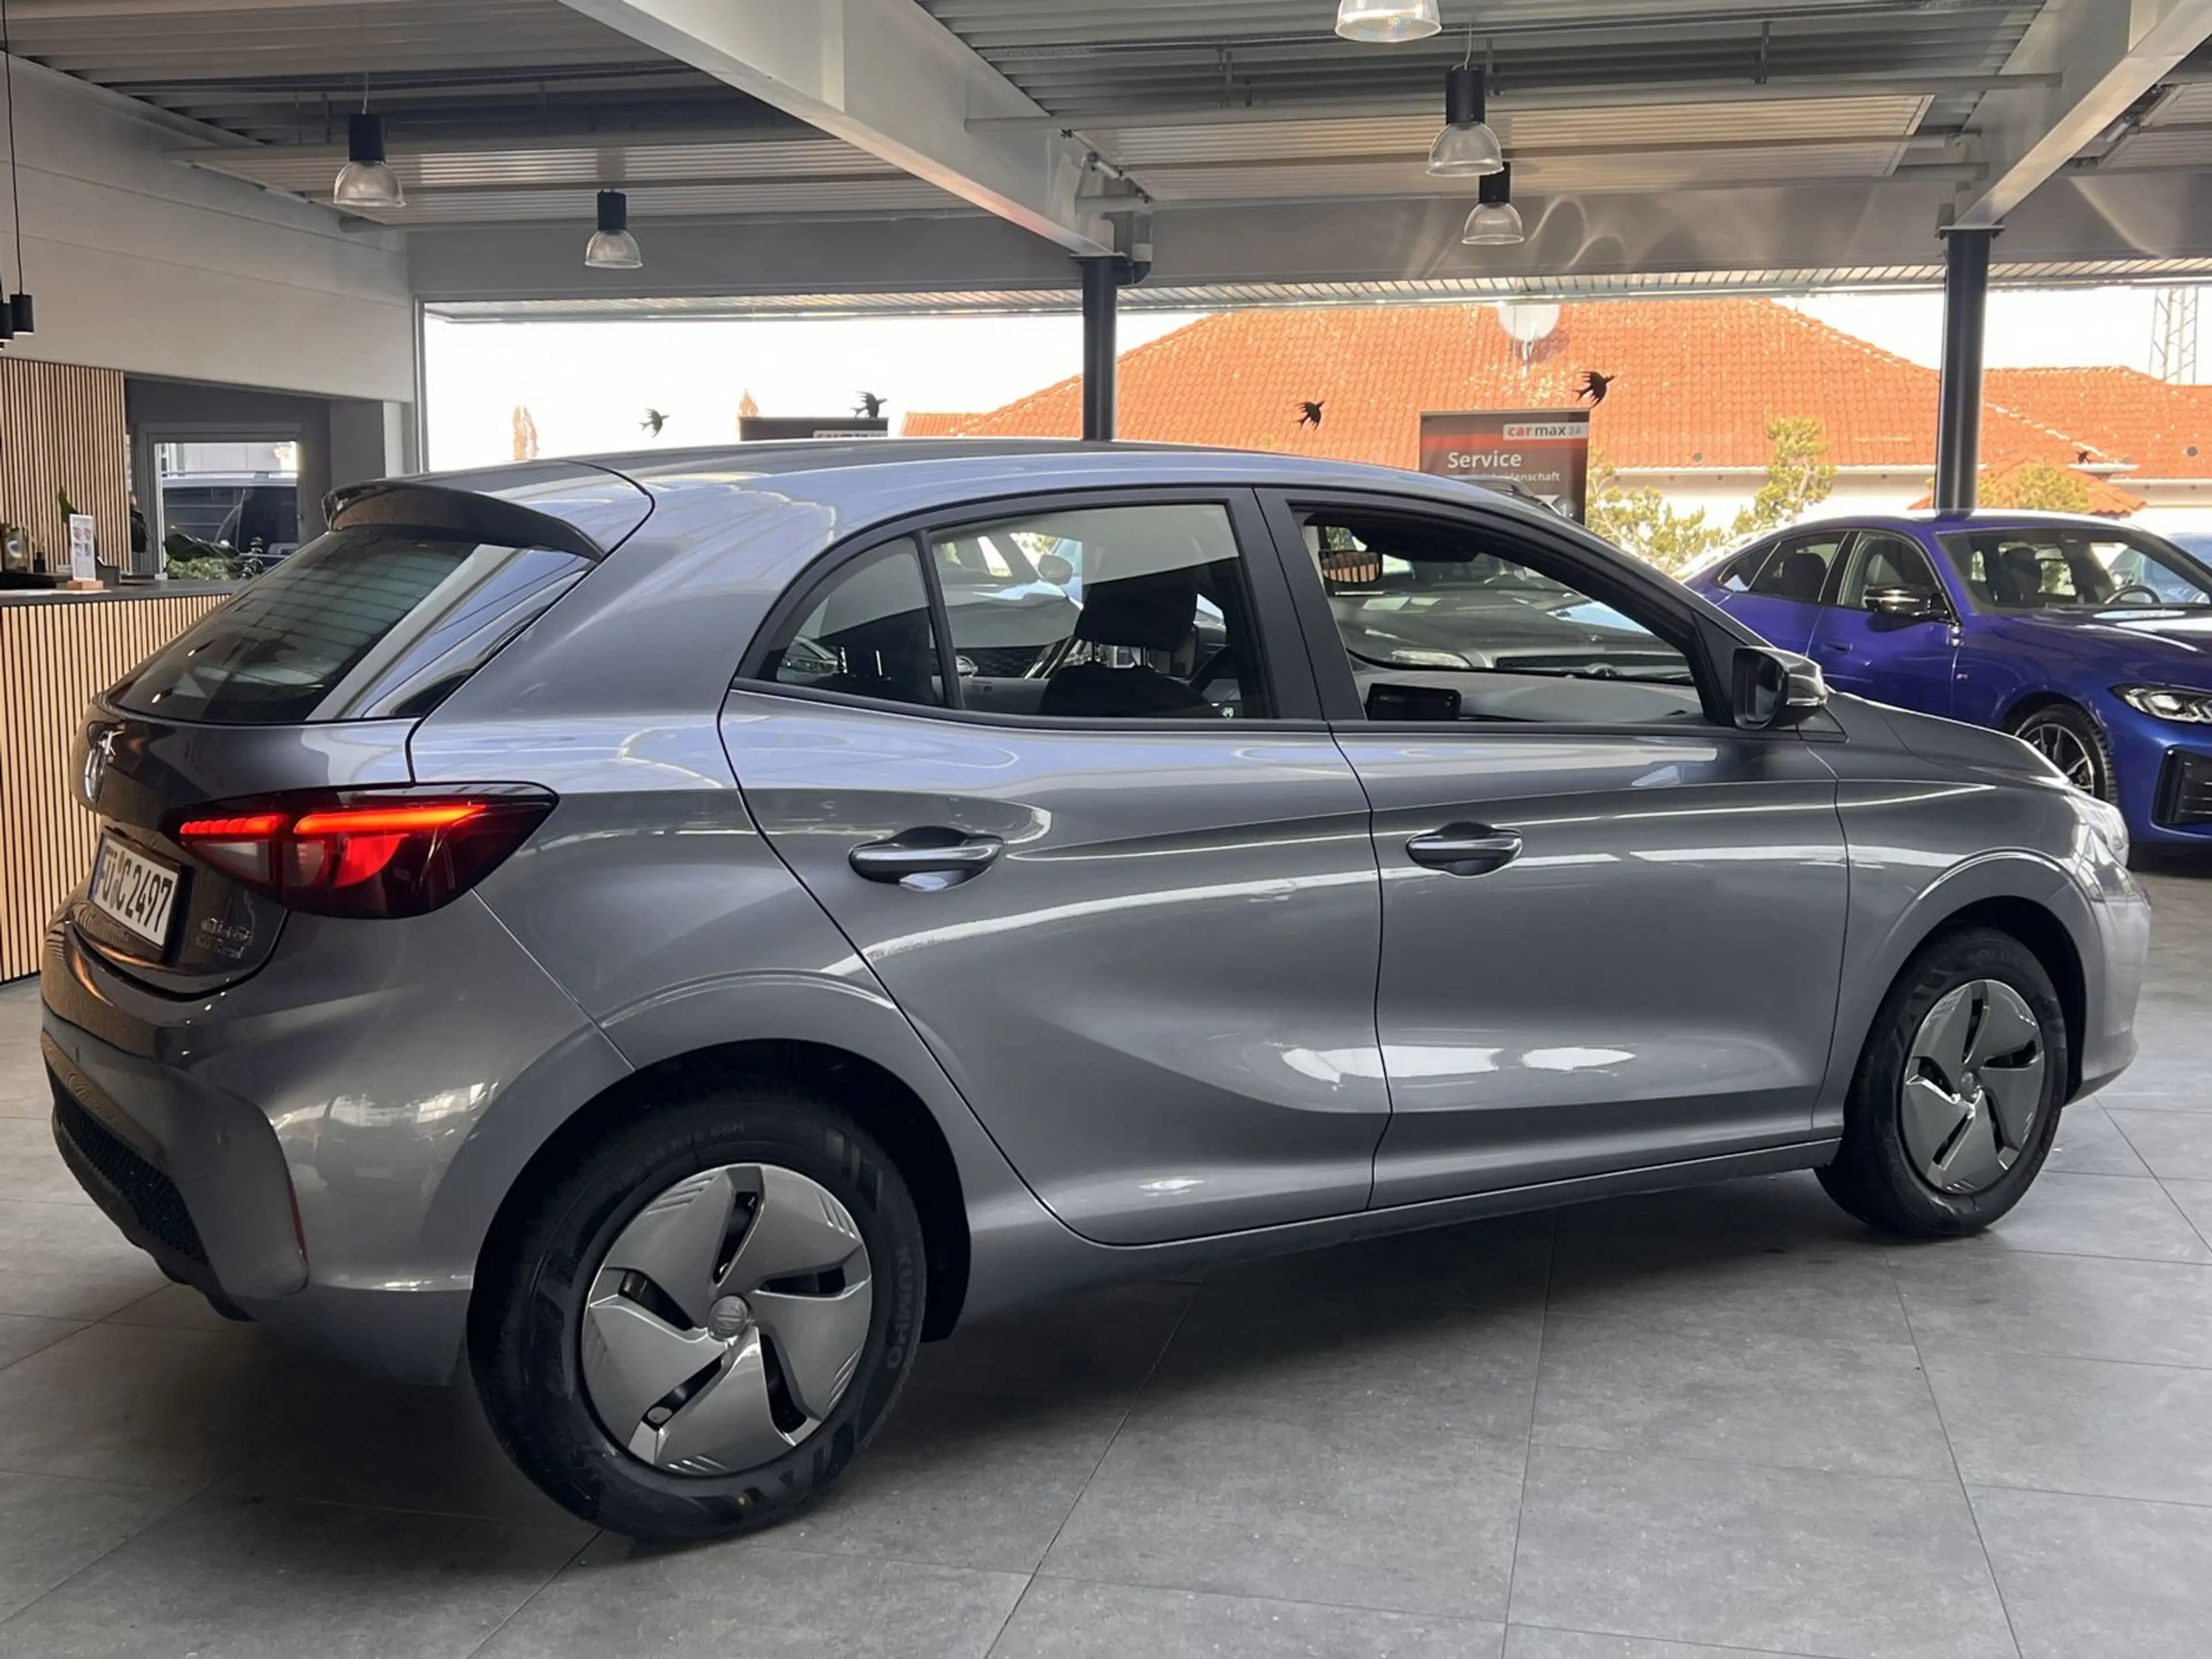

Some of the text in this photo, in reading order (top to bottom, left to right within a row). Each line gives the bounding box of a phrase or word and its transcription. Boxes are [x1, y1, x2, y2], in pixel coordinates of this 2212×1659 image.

[1448, 450, 1522, 468] Service
[124, 864, 172, 933] 2497
[887, 1245, 913, 1369] KUMHO
